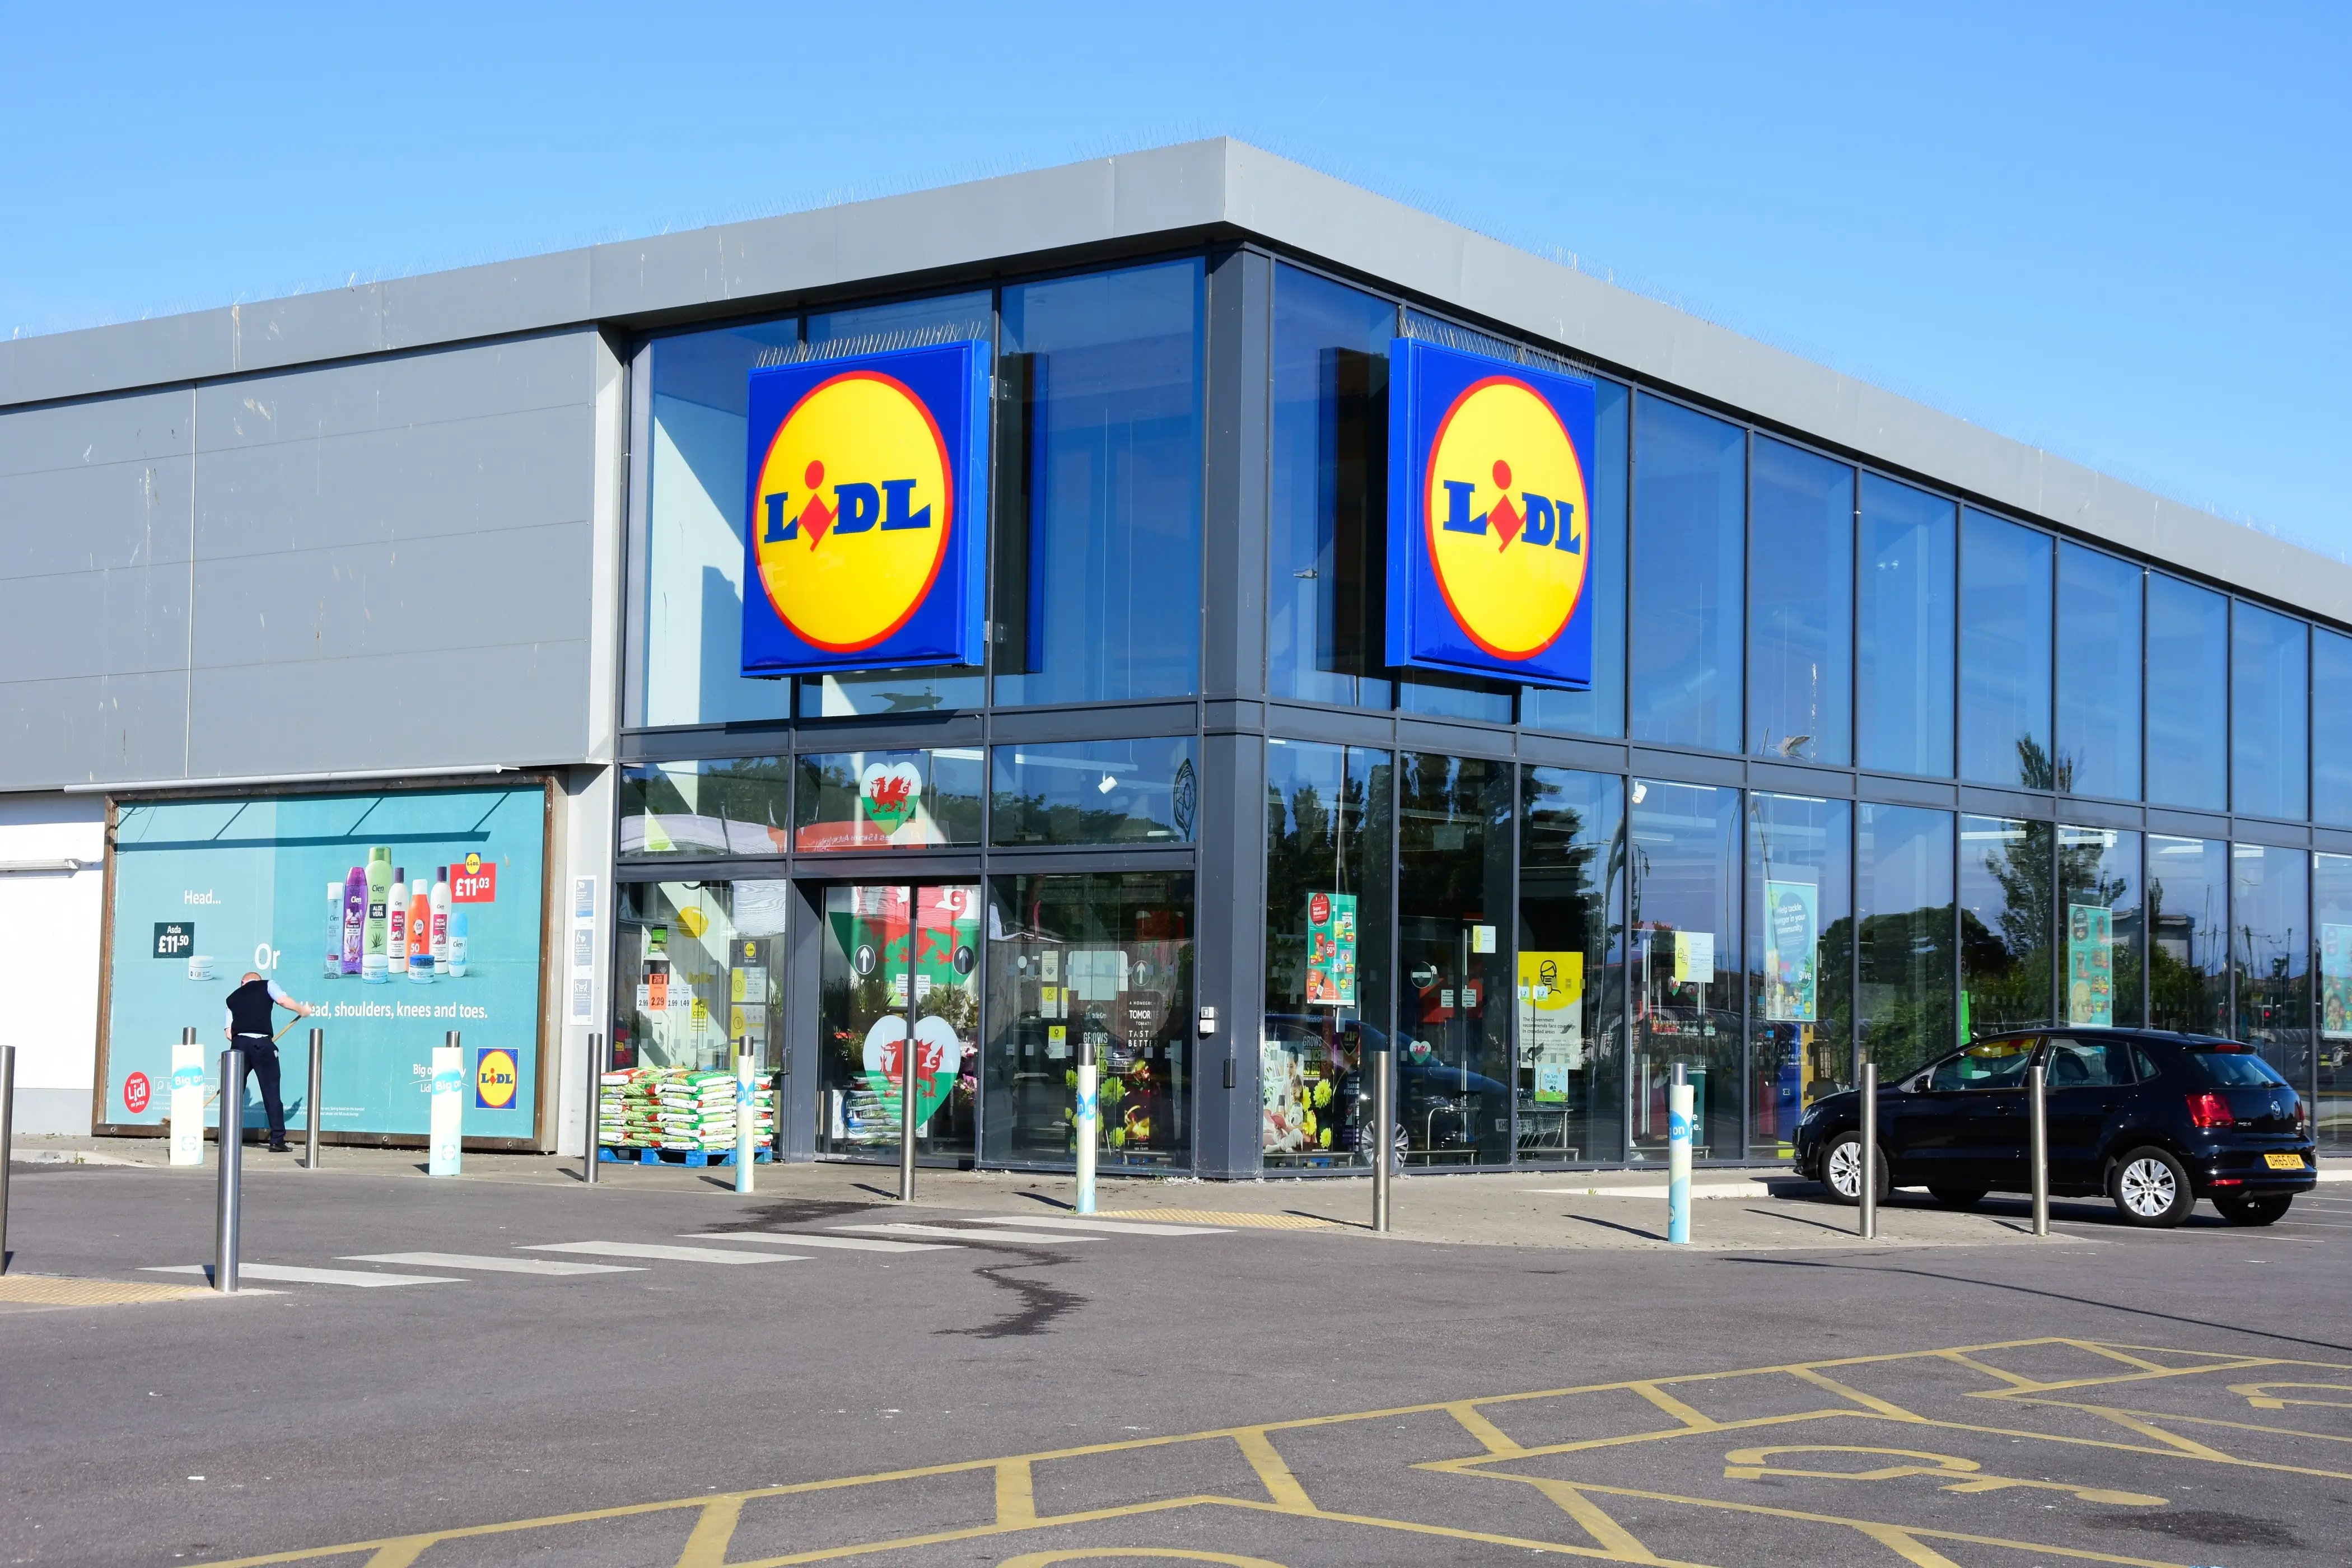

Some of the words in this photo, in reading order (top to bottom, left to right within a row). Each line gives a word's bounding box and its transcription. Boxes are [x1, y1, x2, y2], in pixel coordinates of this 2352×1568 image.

[455, 878, 489, 897] £11.03
[184, 889, 221, 904] Head...
[1789, 903, 1802, 912] tackle
[1795, 914, 1805, 922] your
[158, 935, 189, 953] £11.50
[410, 943, 420, 952] 50
[255, 943, 280, 970] Or
[1798, 971, 1812, 981] give
[651, 997, 664, 1006] 2.29
[301, 1001, 332, 1018] ead,
[335, 1001, 394, 1019] shoulders,
[397, 1001, 431, 1016] knees
[435, 1002, 456, 1018] and
[460, 1004, 488, 1019] toes.
[1129, 1010, 1159, 1019] TOMORITE
[1303, 1036, 1322, 1047] GROWS
[1345, 1032, 1358, 1041] ZIP
[413, 1064, 426, 1077] Big
[421, 1084, 431, 1093] Lidl
[436, 1080, 451, 1091] Big
[454, 1080, 461, 1088] on
[128, 1084, 146, 1102] Lidl
[846, 1096, 871, 1109] Middle
[1673, 1126, 1685, 1135] on
[2269, 1156, 2288, 1166] DH65
[2289, 1156, 2302, 1166] OHX
